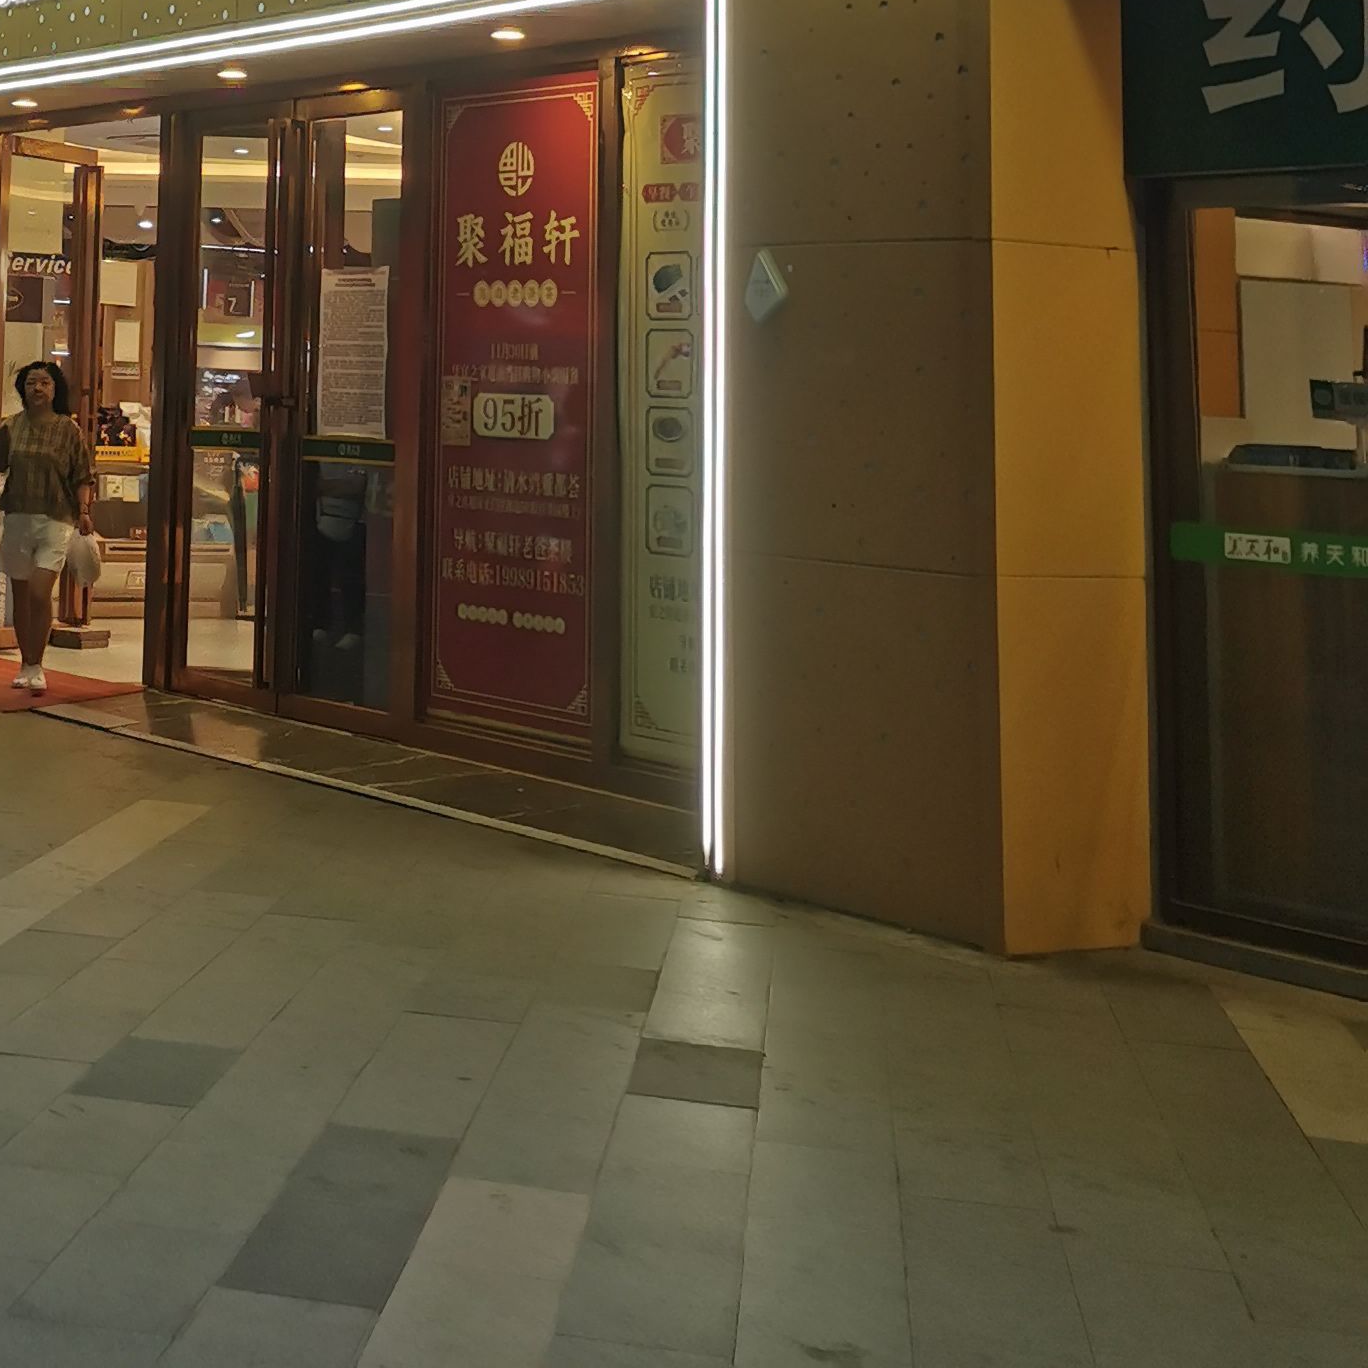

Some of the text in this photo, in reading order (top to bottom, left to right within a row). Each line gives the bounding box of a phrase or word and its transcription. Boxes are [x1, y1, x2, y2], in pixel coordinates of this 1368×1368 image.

[455, 209, 581, 269] 聚福轩
[7, 253, 71, 275] ervic
[483, 396, 544, 437] 95折
